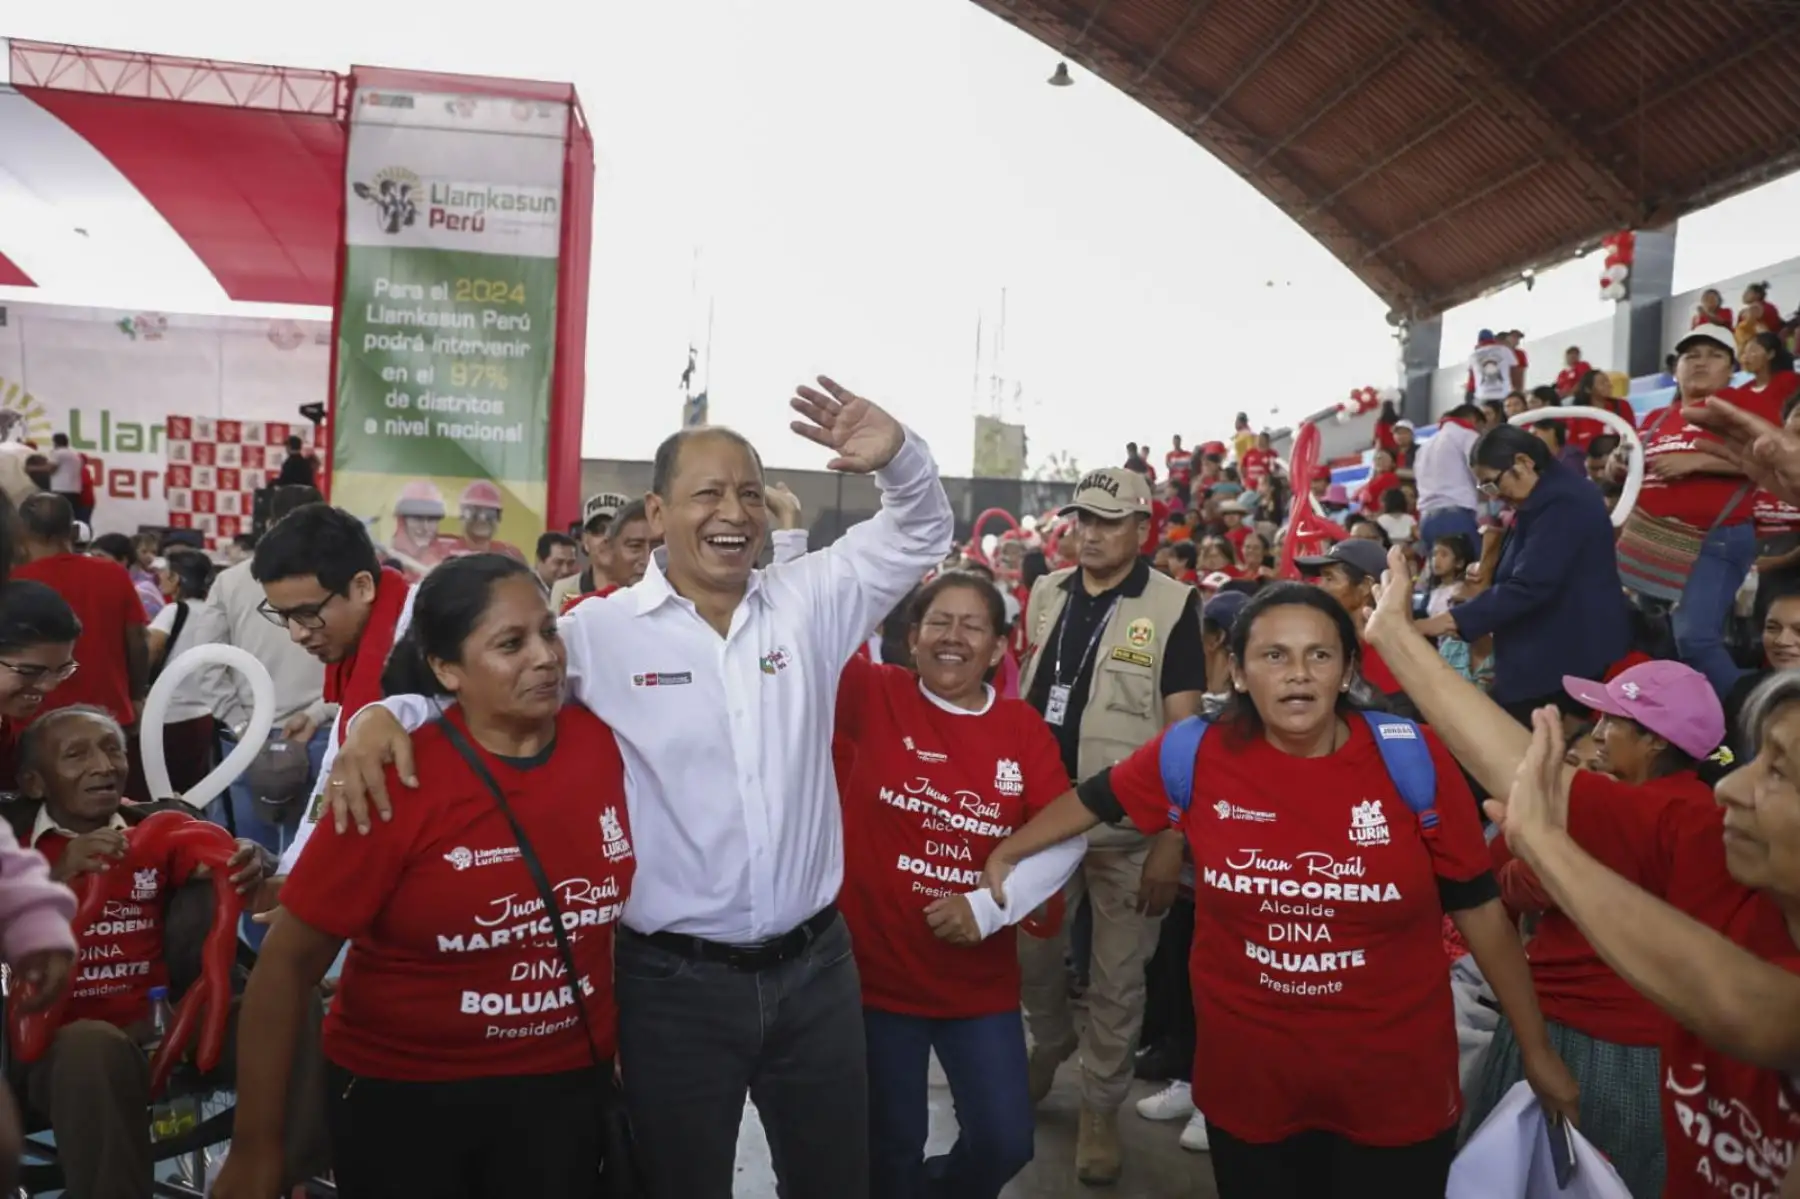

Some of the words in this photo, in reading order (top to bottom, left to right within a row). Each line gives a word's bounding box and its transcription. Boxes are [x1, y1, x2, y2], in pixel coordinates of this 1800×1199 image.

[431, 183, 557, 213] Llamkasun
[429, 208, 485, 233] Perú
[374, 278, 424, 300] Para
[430, 280, 449, 301] el
[455, 277, 526, 305] 2024
[366, 304, 475, 328] Llamkasun
[483, 310, 531, 331] Perú
[364, 331, 424, 352] podrá
[432, 334, 531, 357] intervenir
[381, 367, 408, 383] en
[416, 365, 435, 385] el
[451, 362, 508, 390] 97%
[385, 388, 410, 408] de
[417, 390, 504, 415] distritos
[364, 418, 377, 434] a
[385, 416, 429, 437] nivel
[437, 420, 523, 442] nacional
[954, 790, 1001, 819] Raúl
[925, 840, 972, 861] DINA
[1226, 849, 1292, 871] Juan
[1296, 852, 1366, 880] Raúl
[552, 876, 620, 905] Raúl
[1204, 866, 1402, 903] MARTICORENA
[1259, 900, 1335, 917] Alcalde
[1268, 922, 1332, 942] DINA
[1245, 939, 1366, 972] BOLUARTE
[1260, 972, 1343, 995] Presidente
